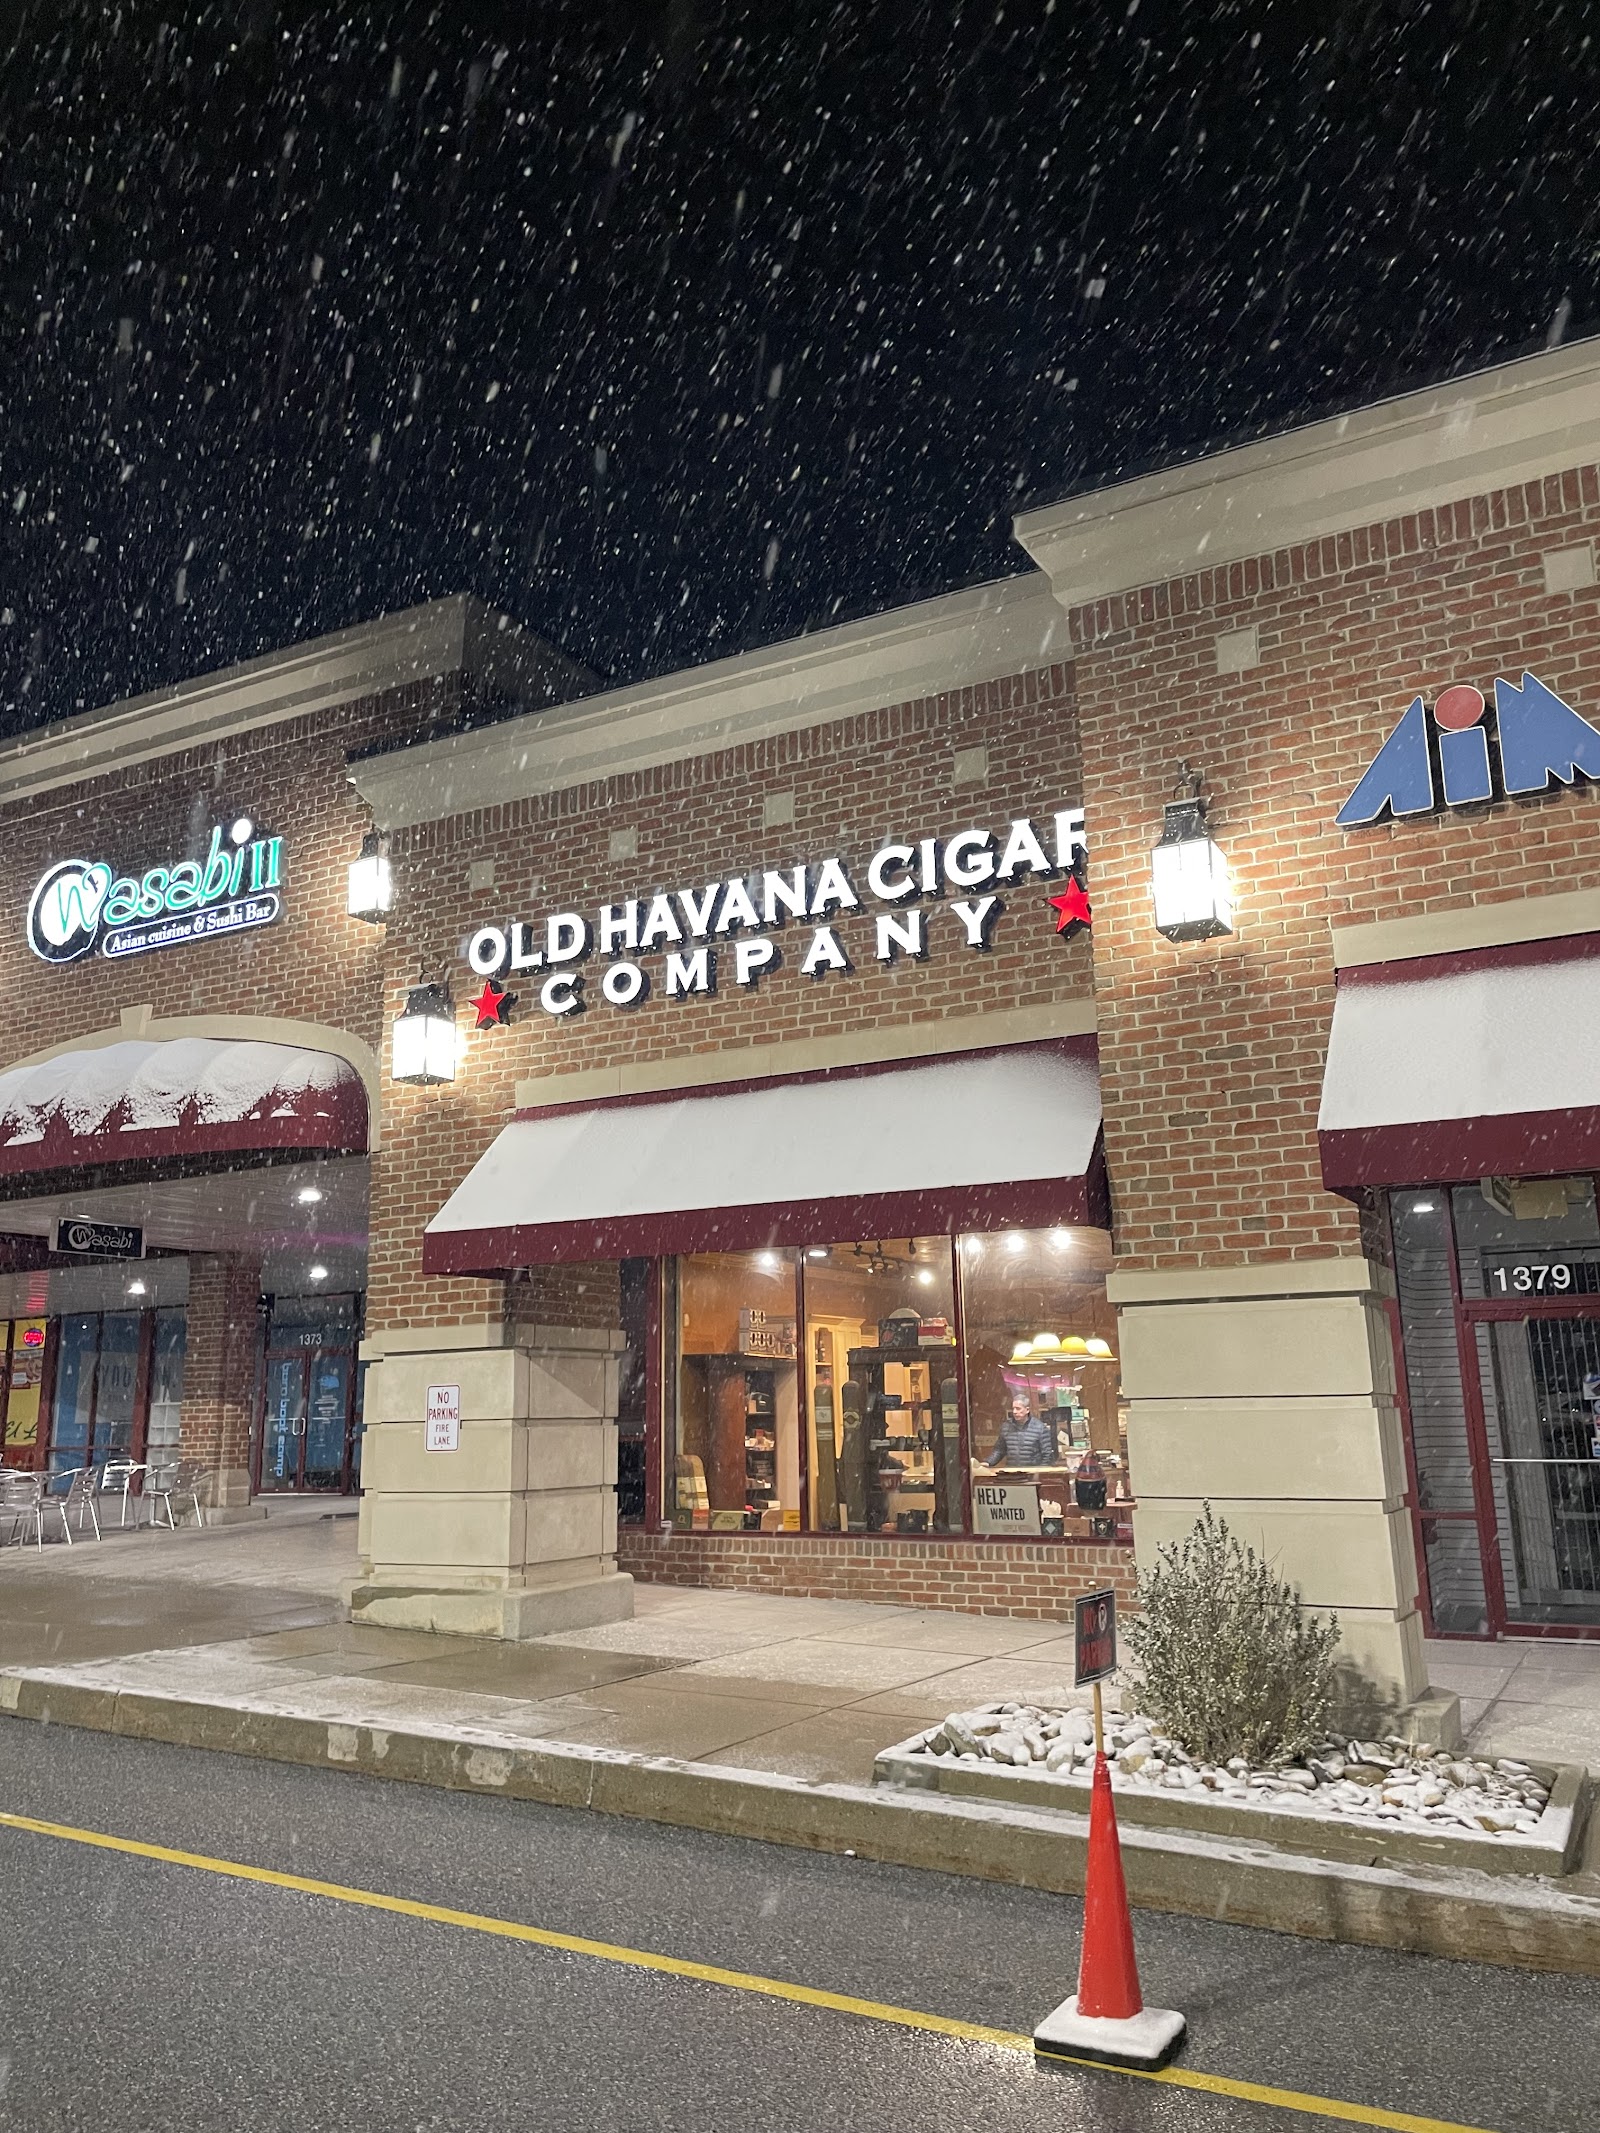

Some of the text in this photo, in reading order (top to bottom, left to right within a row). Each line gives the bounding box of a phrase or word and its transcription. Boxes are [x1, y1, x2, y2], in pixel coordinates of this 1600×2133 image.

[52, 819, 252, 936] Wasabi
[468, 808, 1089, 976] OLD HAVANA CIGAR
[110, 903, 271, 953] Asian cuisine & Sushi Bar
[540, 896, 999, 1014] COMPANY
[68, 1224, 133, 1249] Wasabi
[1494, 1264, 1571, 1292] 1379
[299, 1333, 322, 1346] 1373
[437, 1391, 450, 1404] NO
[278, 1398, 291, 1433] boot
[428, 1407, 458, 1420] PARKING
[434, 1436, 450, 1446] LANE
[435, 1424, 449, 1433] FIRE
[274, 1435, 286, 1477] camp
[977, 1488, 1007, 1505] HELP
[990, 1508, 1026, 1521] WANTED
